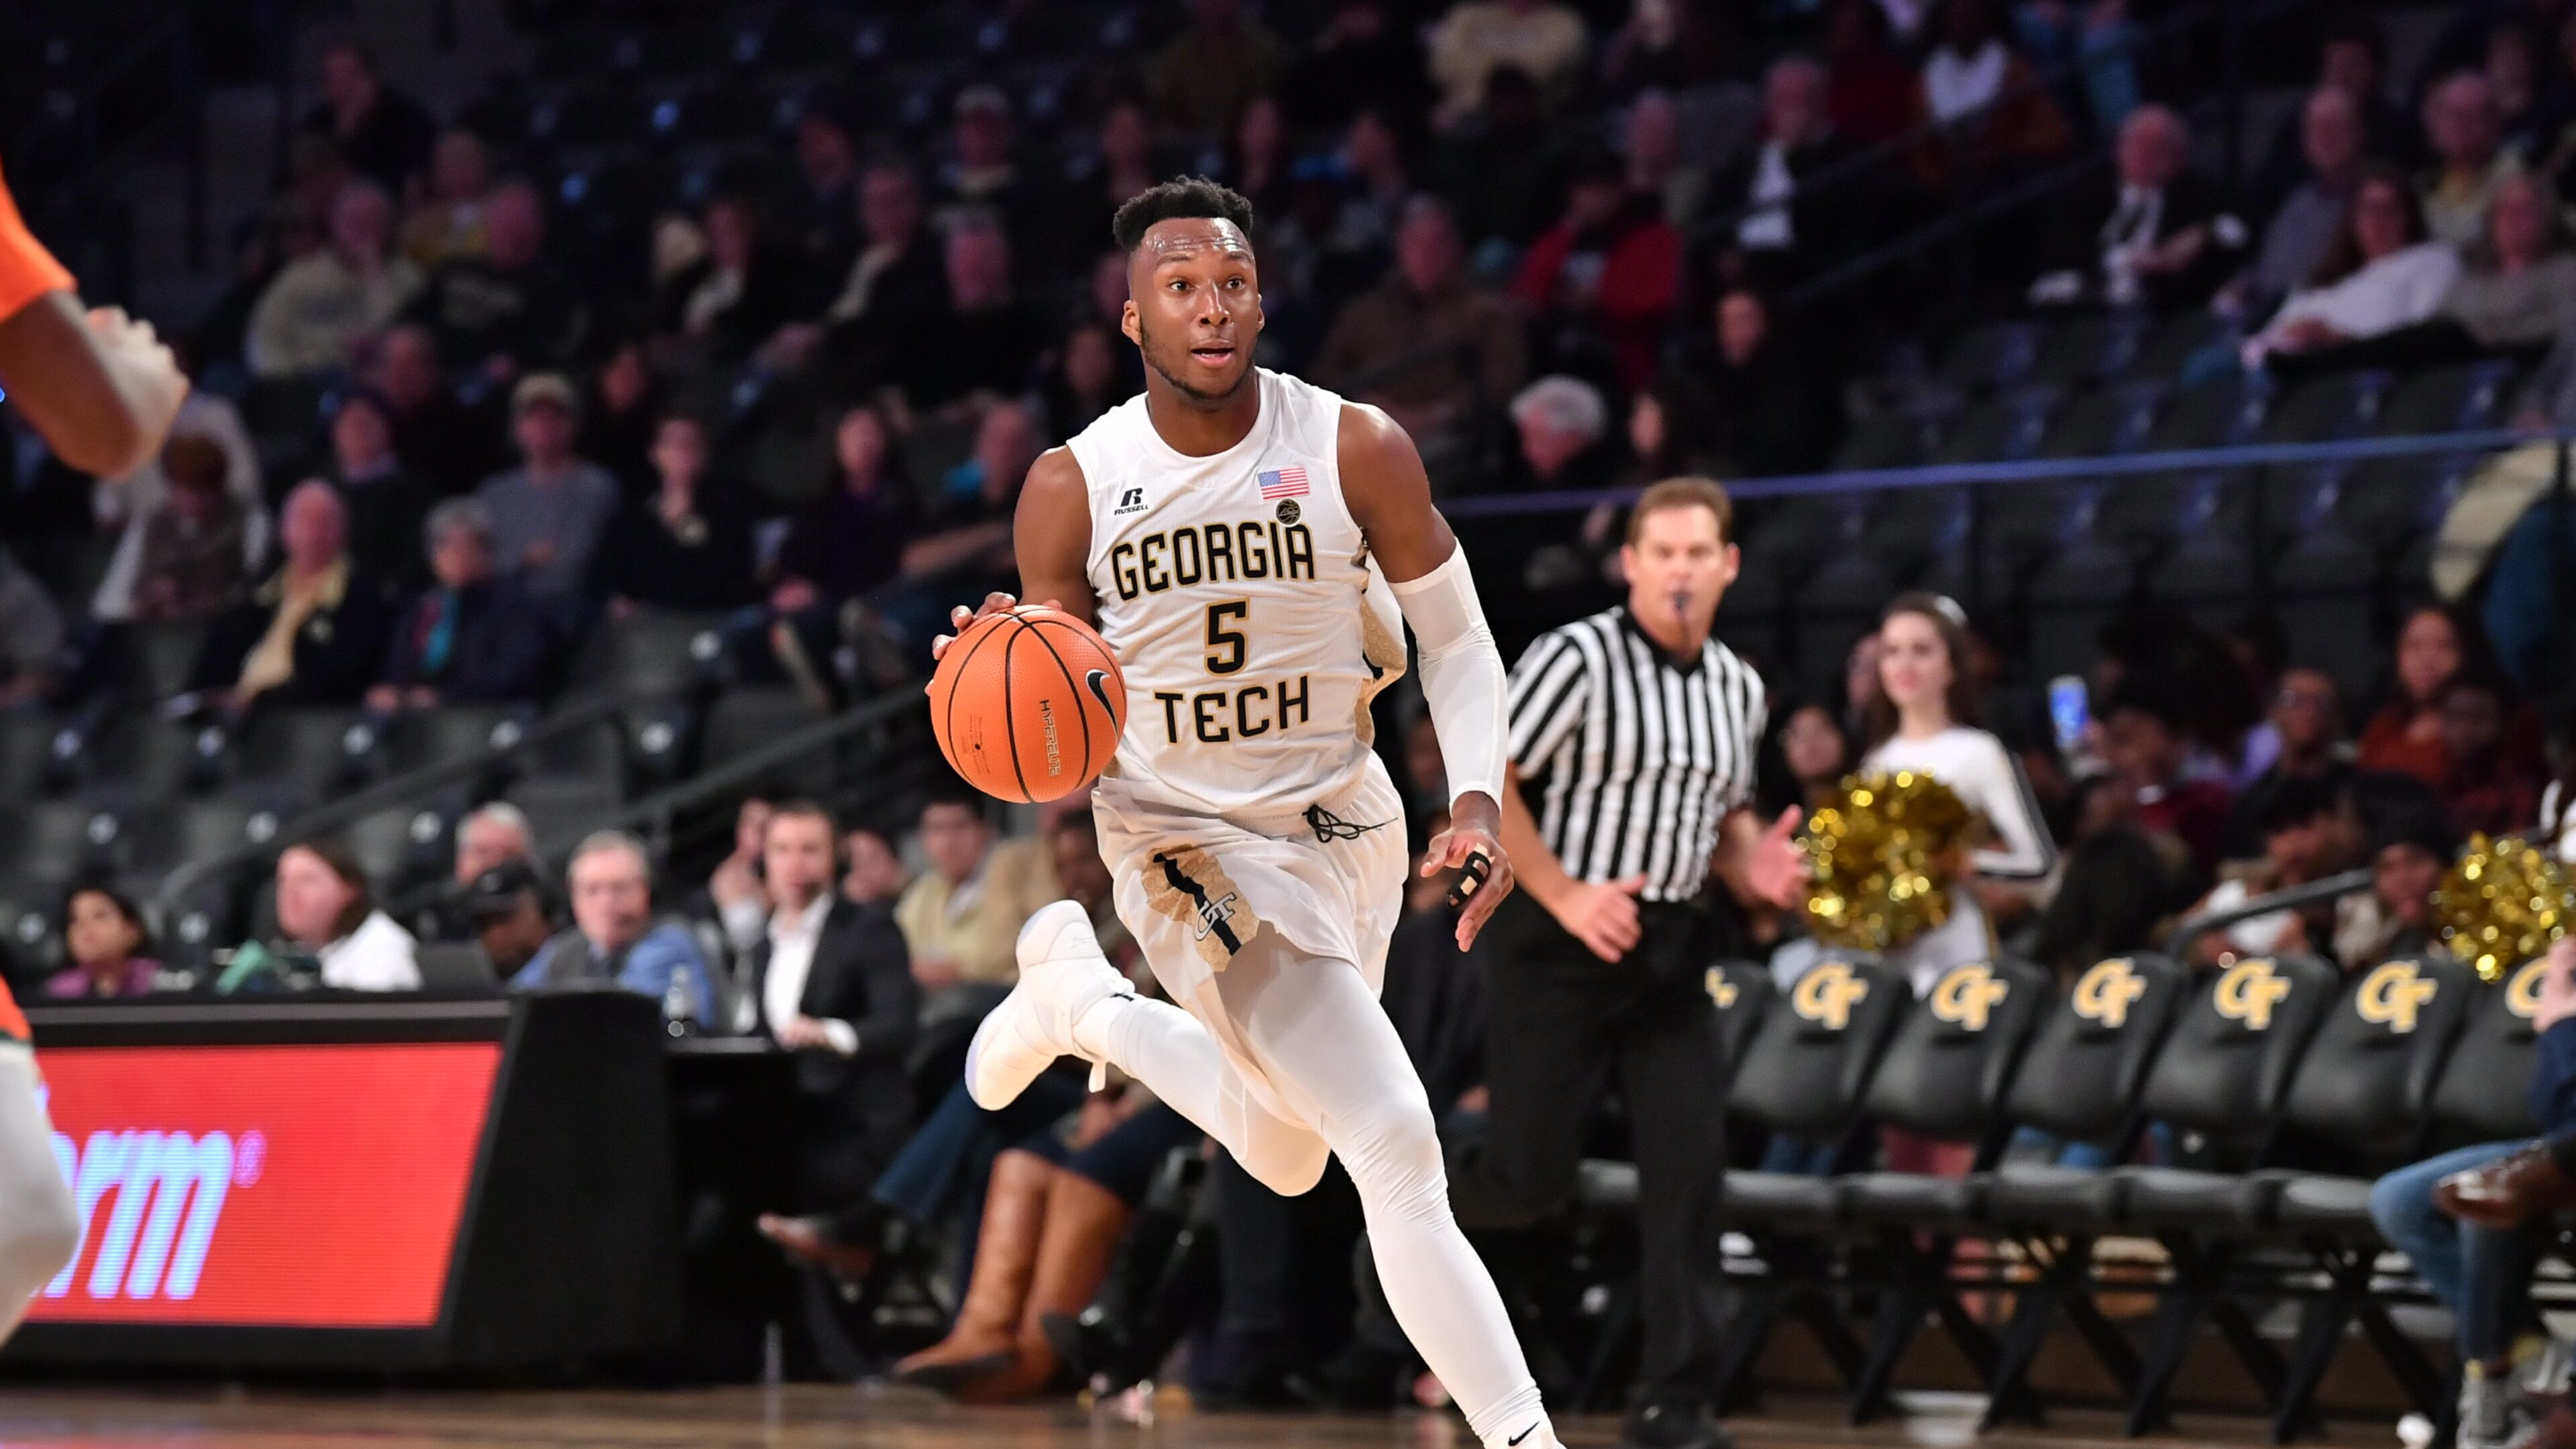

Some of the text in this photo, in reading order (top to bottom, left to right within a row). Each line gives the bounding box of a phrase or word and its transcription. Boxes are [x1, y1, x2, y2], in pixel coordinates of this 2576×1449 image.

[1114, 504, 1149, 516] RUSSELL
[1279, 506, 1299, 515] ACC
[1111, 521, 1316, 602] GEORGIA
[1204, 596, 1250, 677] 5
[1039, 700, 1061, 776] HYPERELITE
[1153, 673, 1310, 745] TECH
